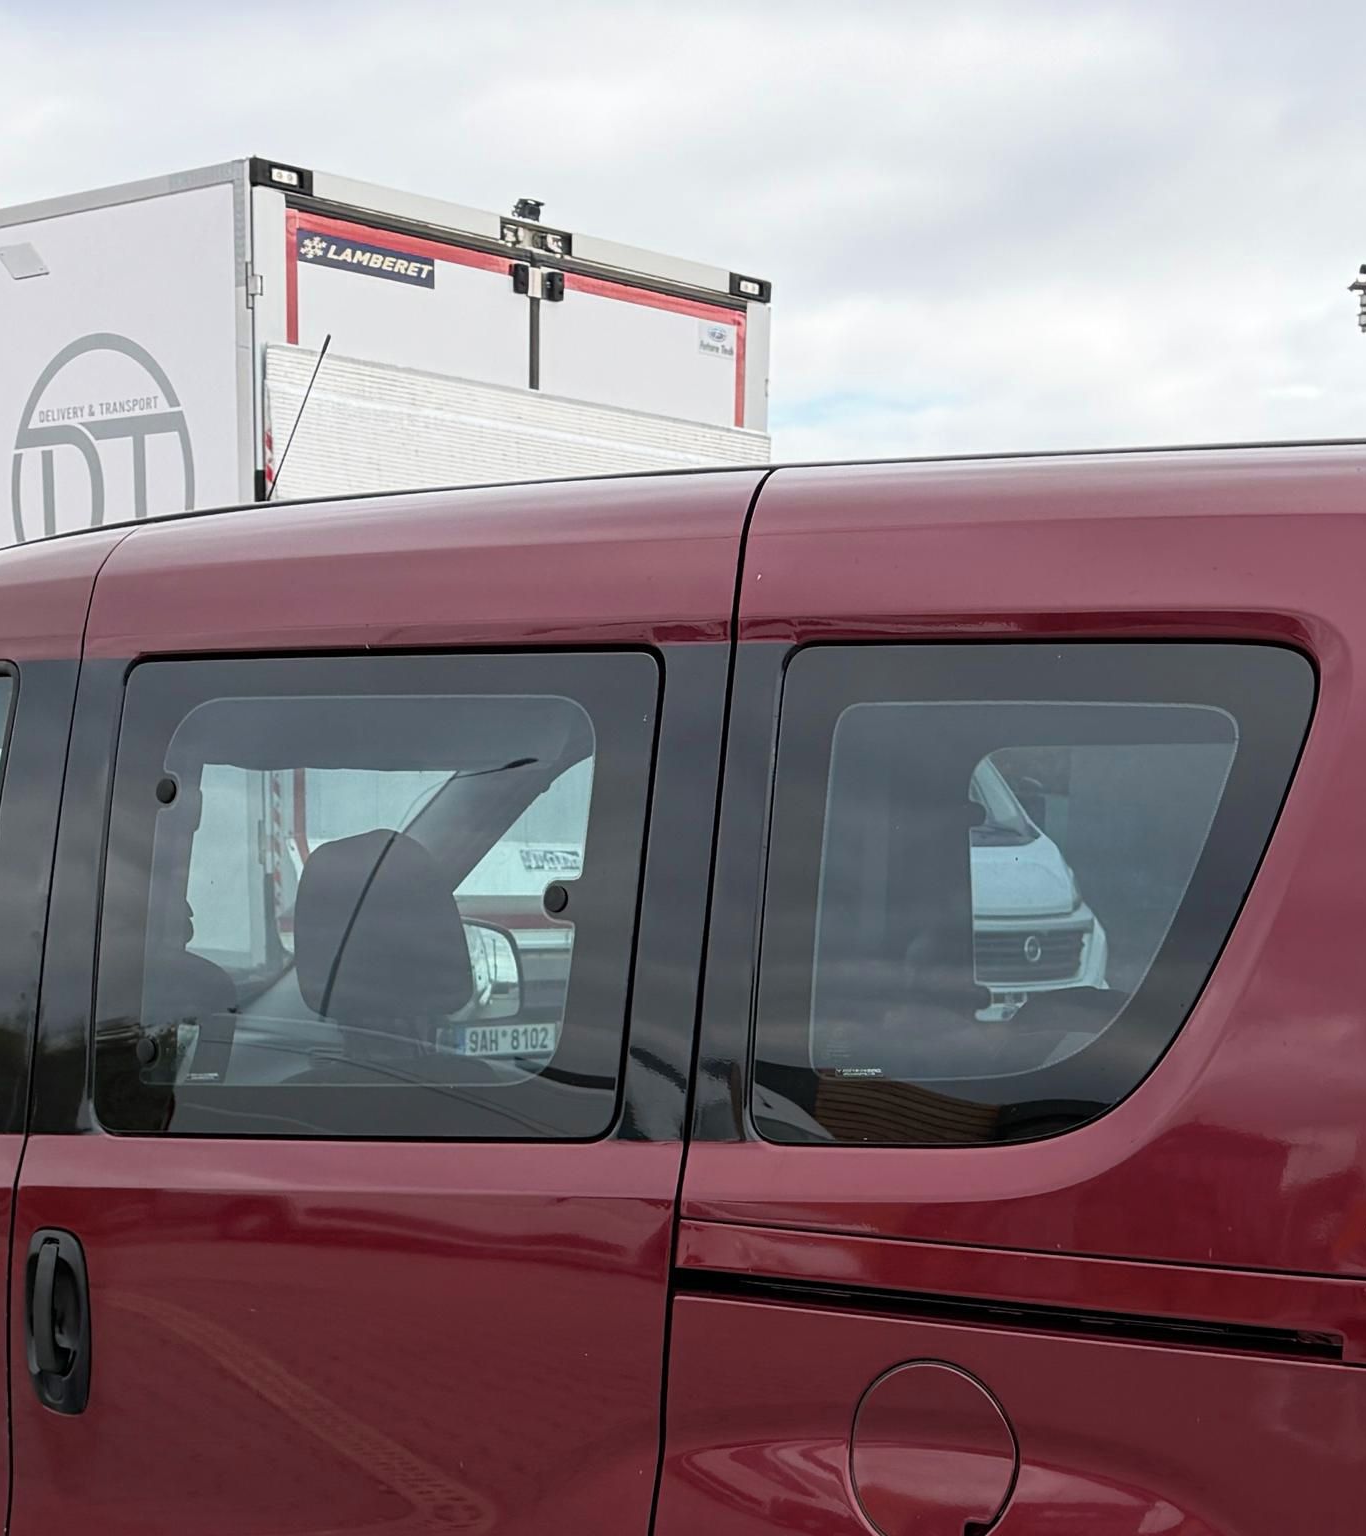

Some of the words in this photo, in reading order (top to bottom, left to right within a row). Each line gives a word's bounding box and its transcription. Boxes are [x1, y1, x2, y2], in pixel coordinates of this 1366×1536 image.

[326, 244, 434, 279] LAMBERET
[38, 405, 85, 424] DELIVERY
[87, 403, 96, 417] &
[98, 395, 159, 417] TRANSPORT
[469, 1029, 499, 1052] 9AH
[510, 1026, 549, 1050] 8102
